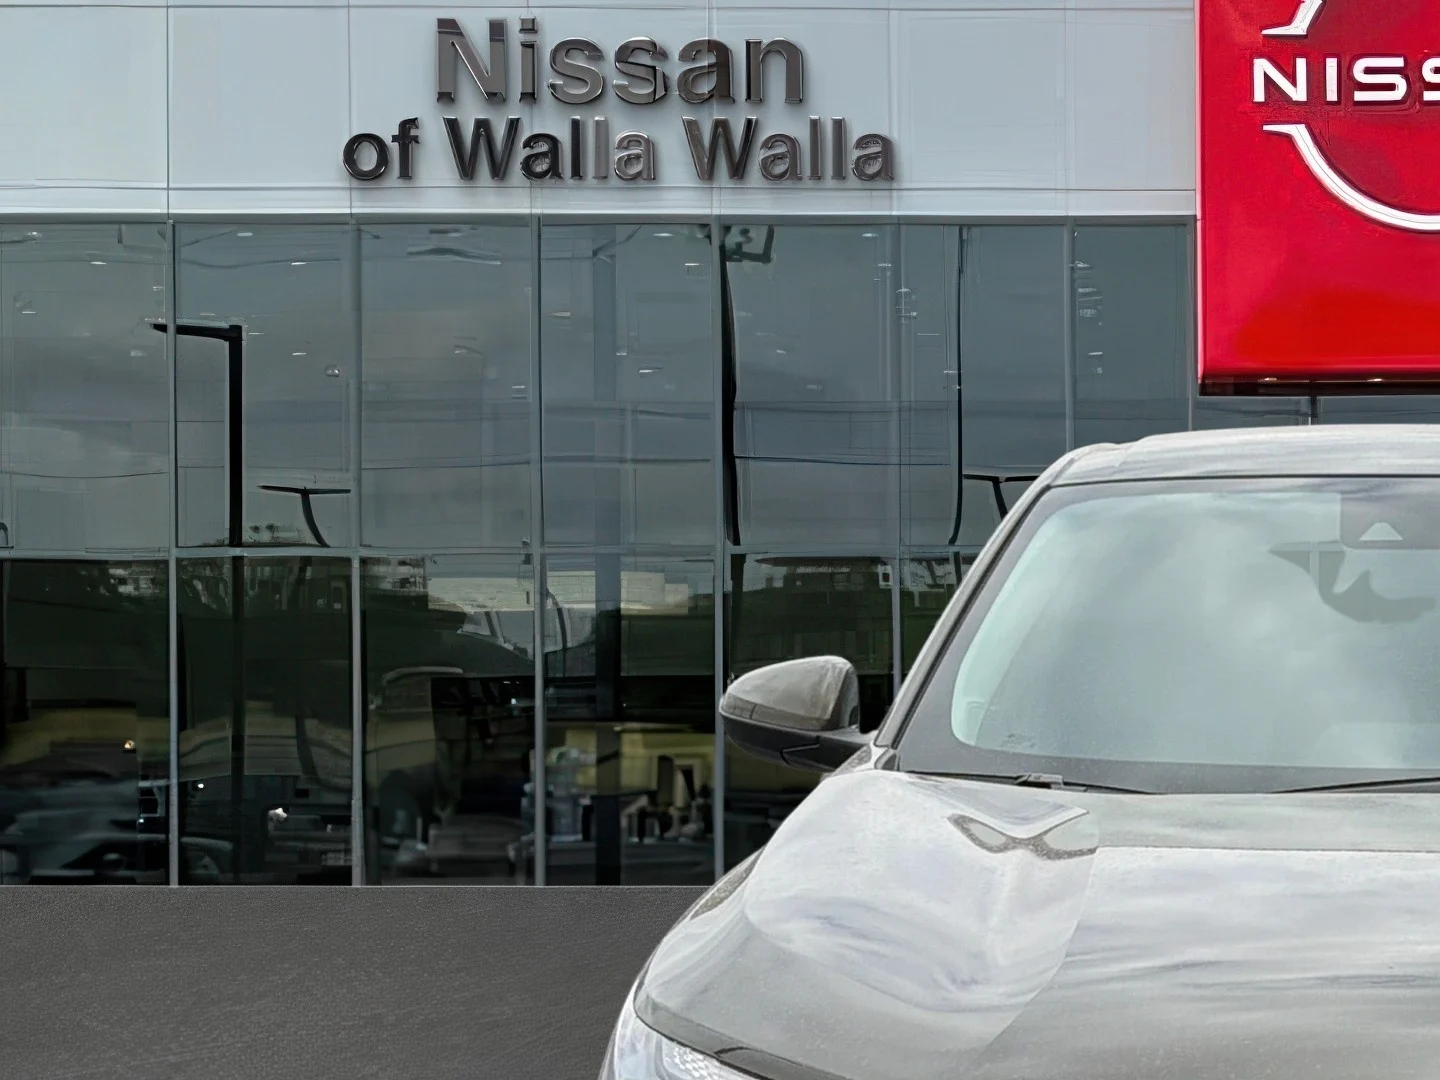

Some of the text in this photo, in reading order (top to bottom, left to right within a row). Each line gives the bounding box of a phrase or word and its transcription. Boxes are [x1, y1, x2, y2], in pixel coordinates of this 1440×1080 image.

[435, 17, 805, 104] Nissan
[342, 115, 895, 181] of Walla Walla
